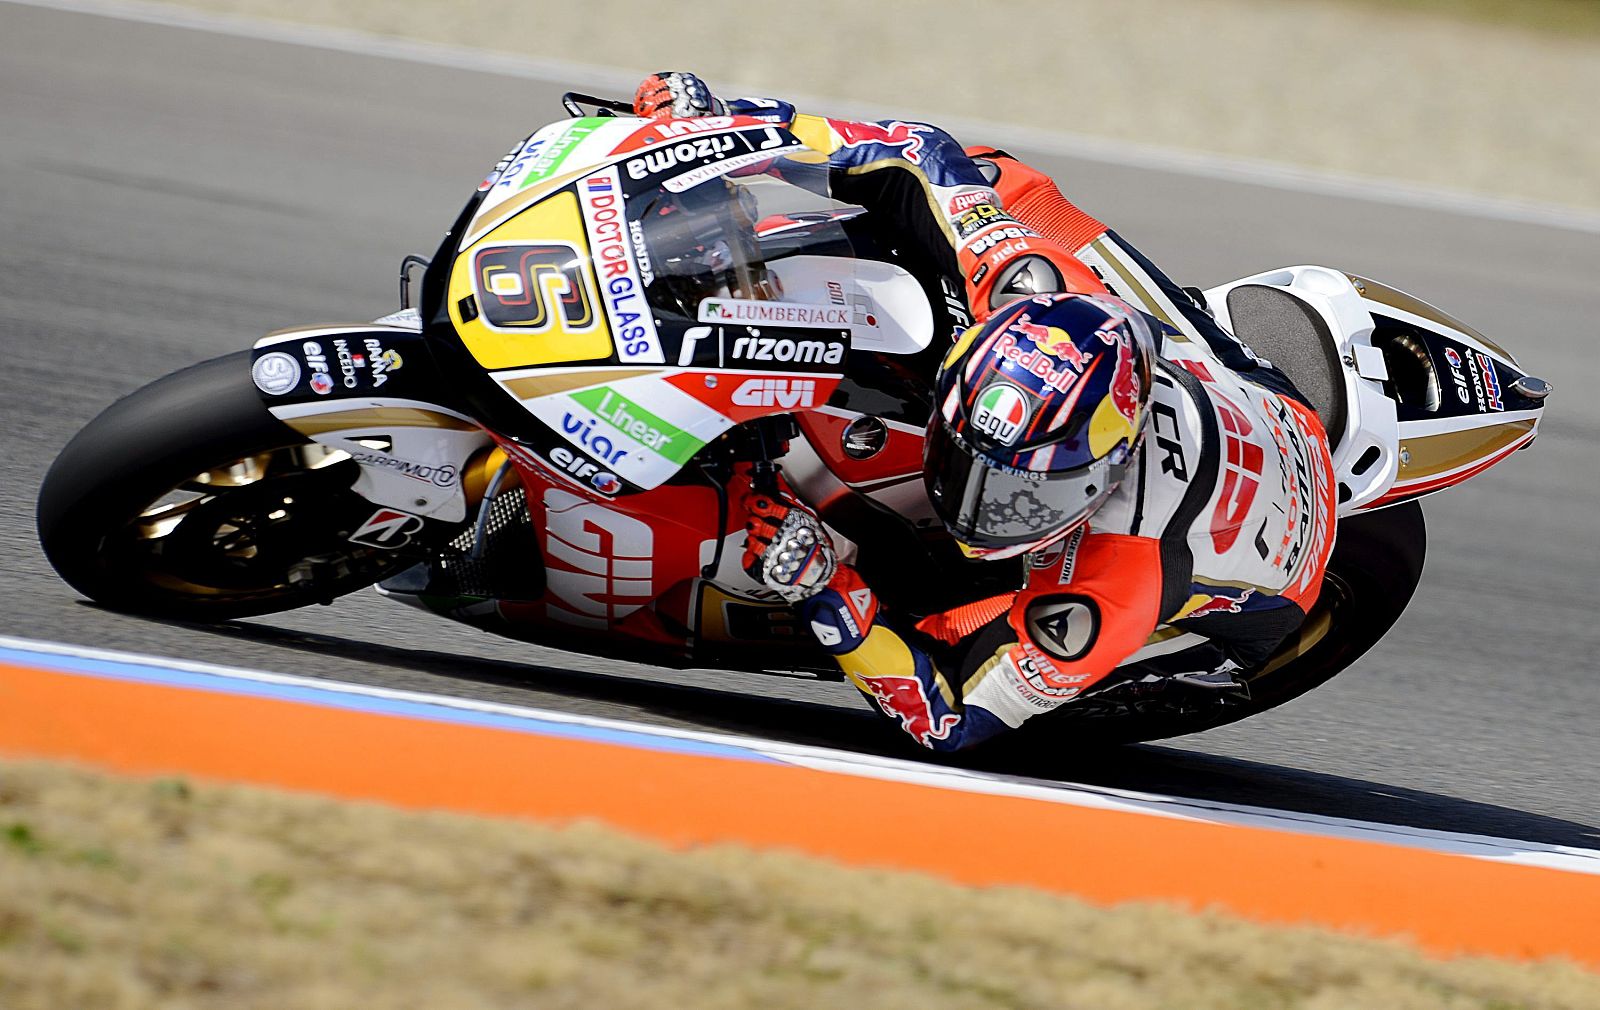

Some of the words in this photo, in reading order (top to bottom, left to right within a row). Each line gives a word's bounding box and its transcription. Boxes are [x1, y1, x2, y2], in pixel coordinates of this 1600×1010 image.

[627, 135, 735, 180] rizoma
[628, 219, 655, 288] HONDA
[735, 304, 849, 325] LUMBERJACK
[302, 341, 330, 374] elf
[731, 328, 845, 365] rizoma
[731, 378, 816, 409] GIVI
[1451, 366, 1470, 404] elf
[1465, 348, 1487, 413] HONDA
[1476, 352, 1505, 412] HRC
[560, 411, 629, 466] viar
[596, 390, 673, 451] Linear
[549, 447, 600, 479] elf
[1001, 462, 1049, 482] WINGS
